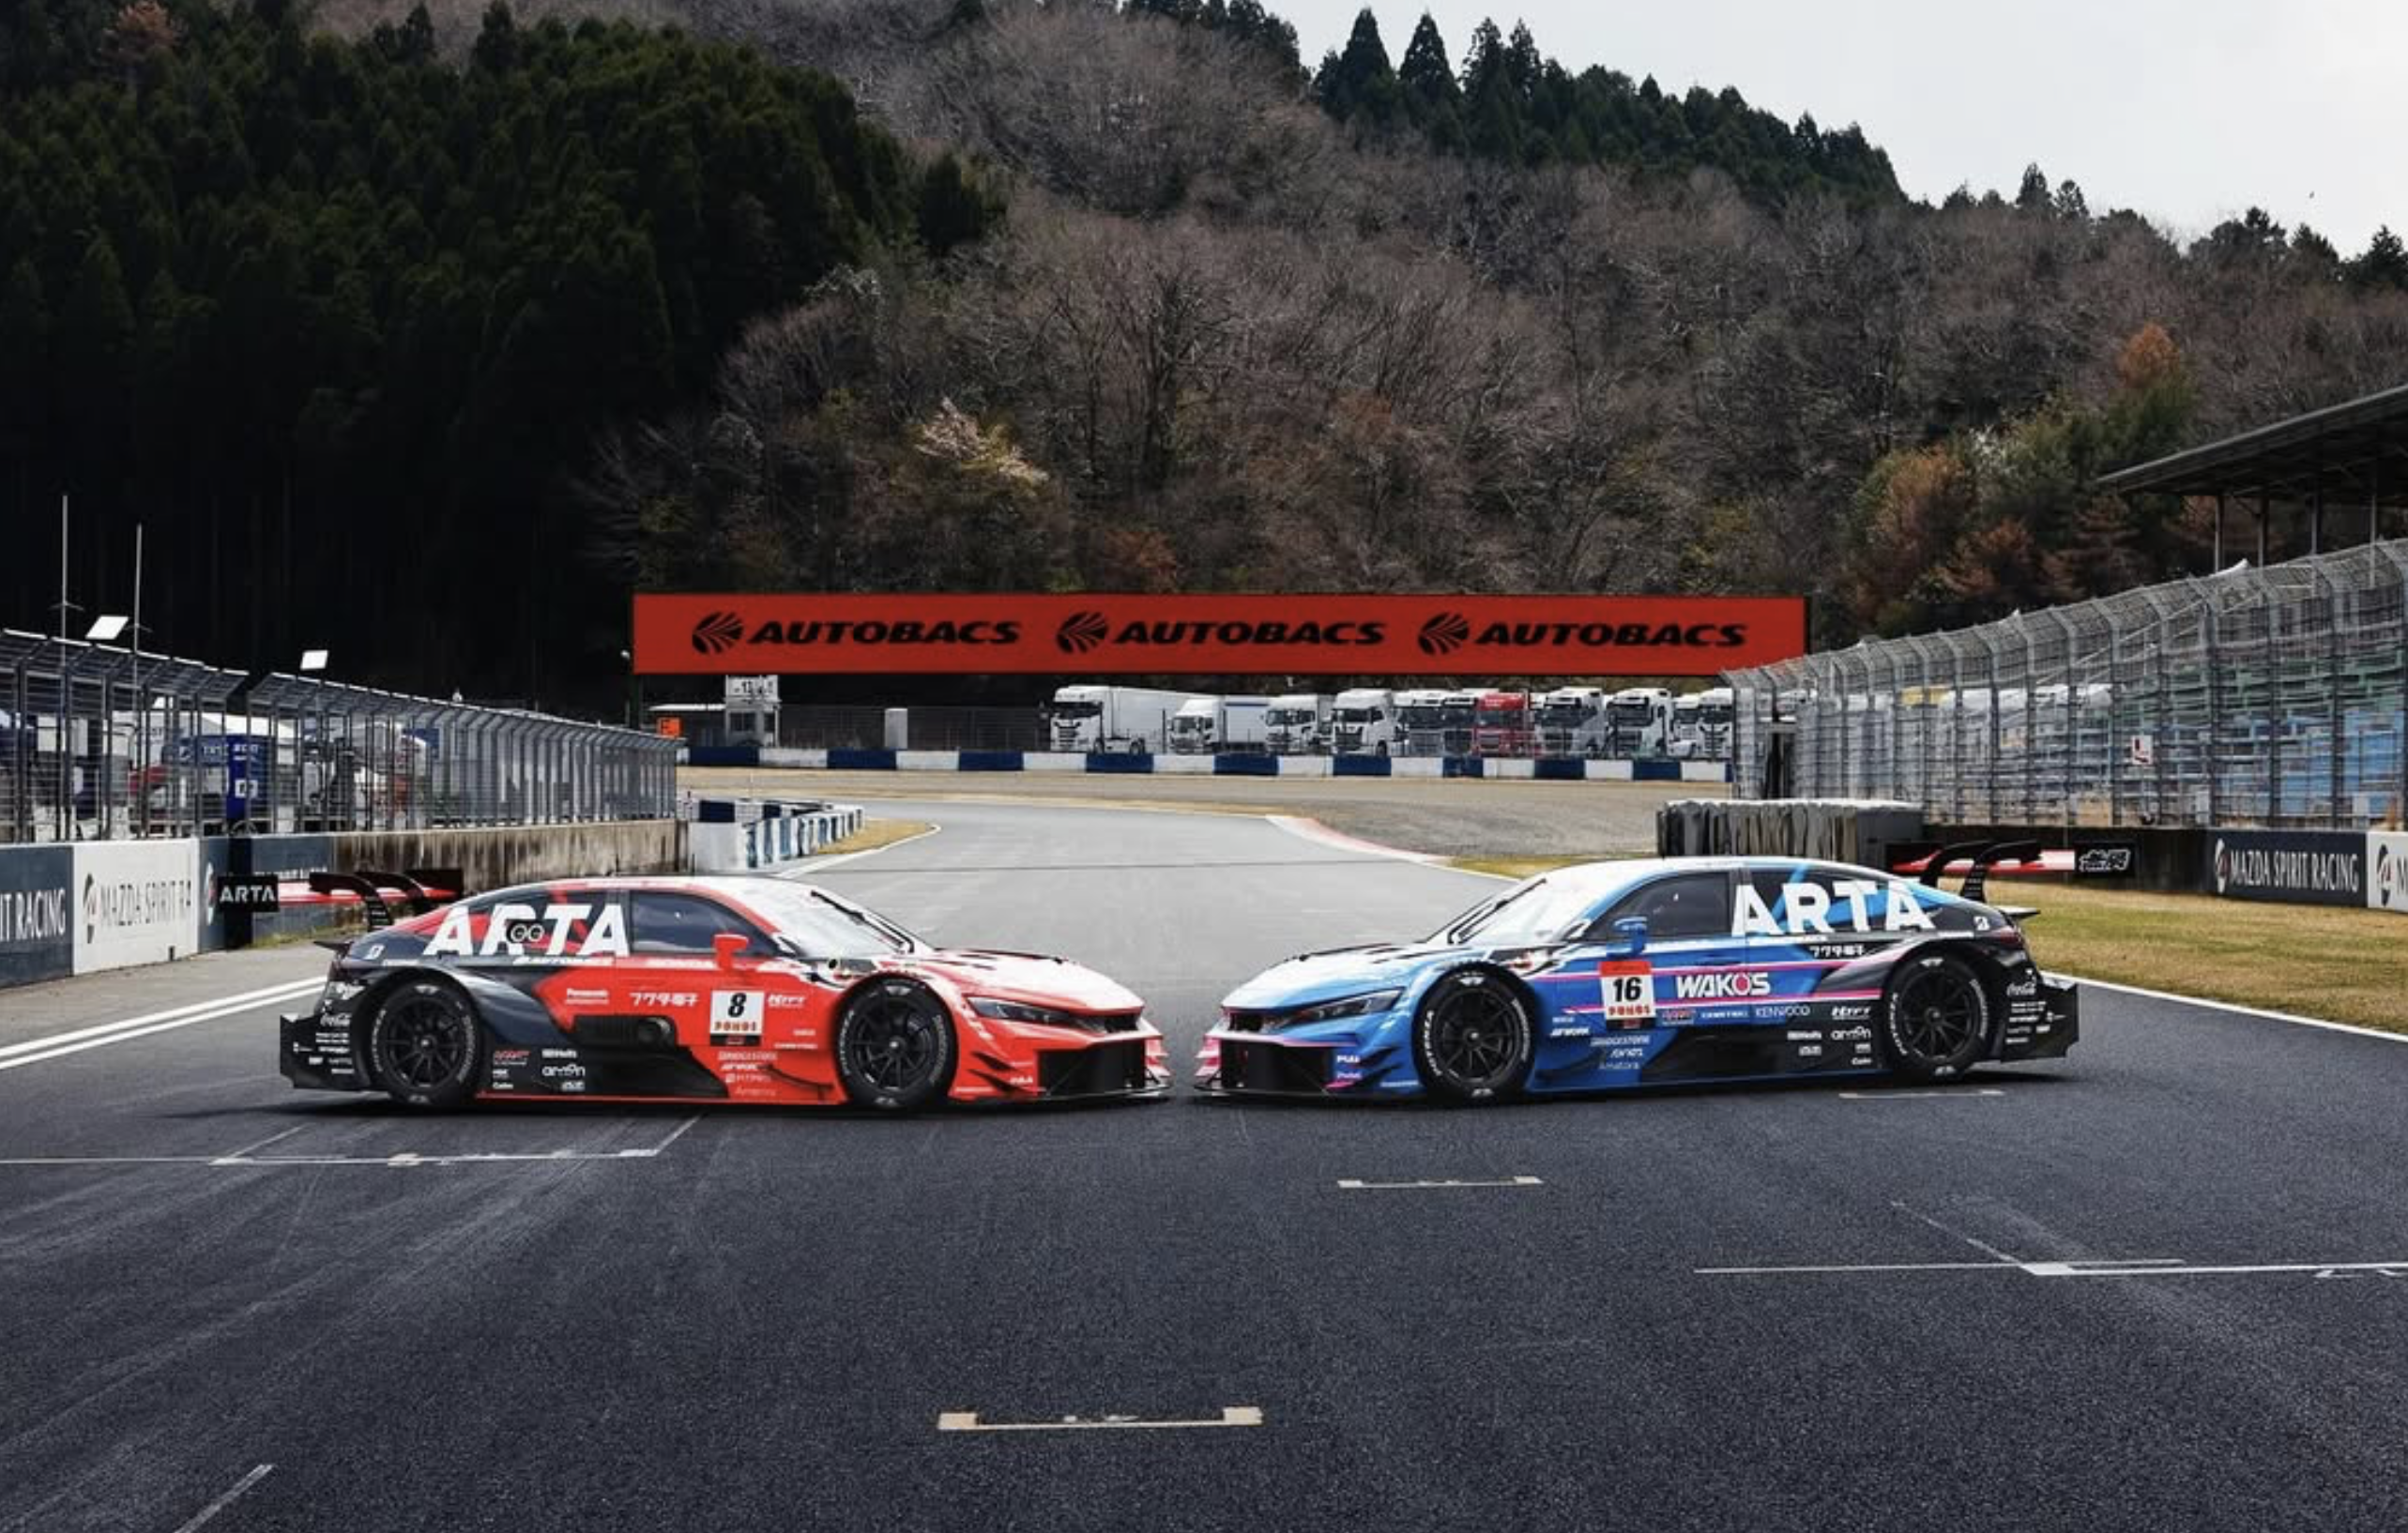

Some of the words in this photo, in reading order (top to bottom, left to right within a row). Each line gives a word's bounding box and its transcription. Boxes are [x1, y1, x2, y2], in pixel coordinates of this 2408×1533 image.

[748, 621, 1020, 645] AUTOBACS
[1113, 621, 1385, 645] AUTOBACS
[1474, 623, 1747, 646] AUTOBACS
[2231, 849, 2271, 887] MAZDA
[2273, 851, 2309, 889] SPIRIT
[2310, 853, 2359, 892] RACING
[220, 885, 276, 903] ARTA
[1730, 876, 1937, 937] ARTA
[15, 887, 67, 941] RACING
[422, 903, 631, 957] ARTA
[1612, 977, 1642, 1003] 16
[727, 993, 747, 1018] 8
